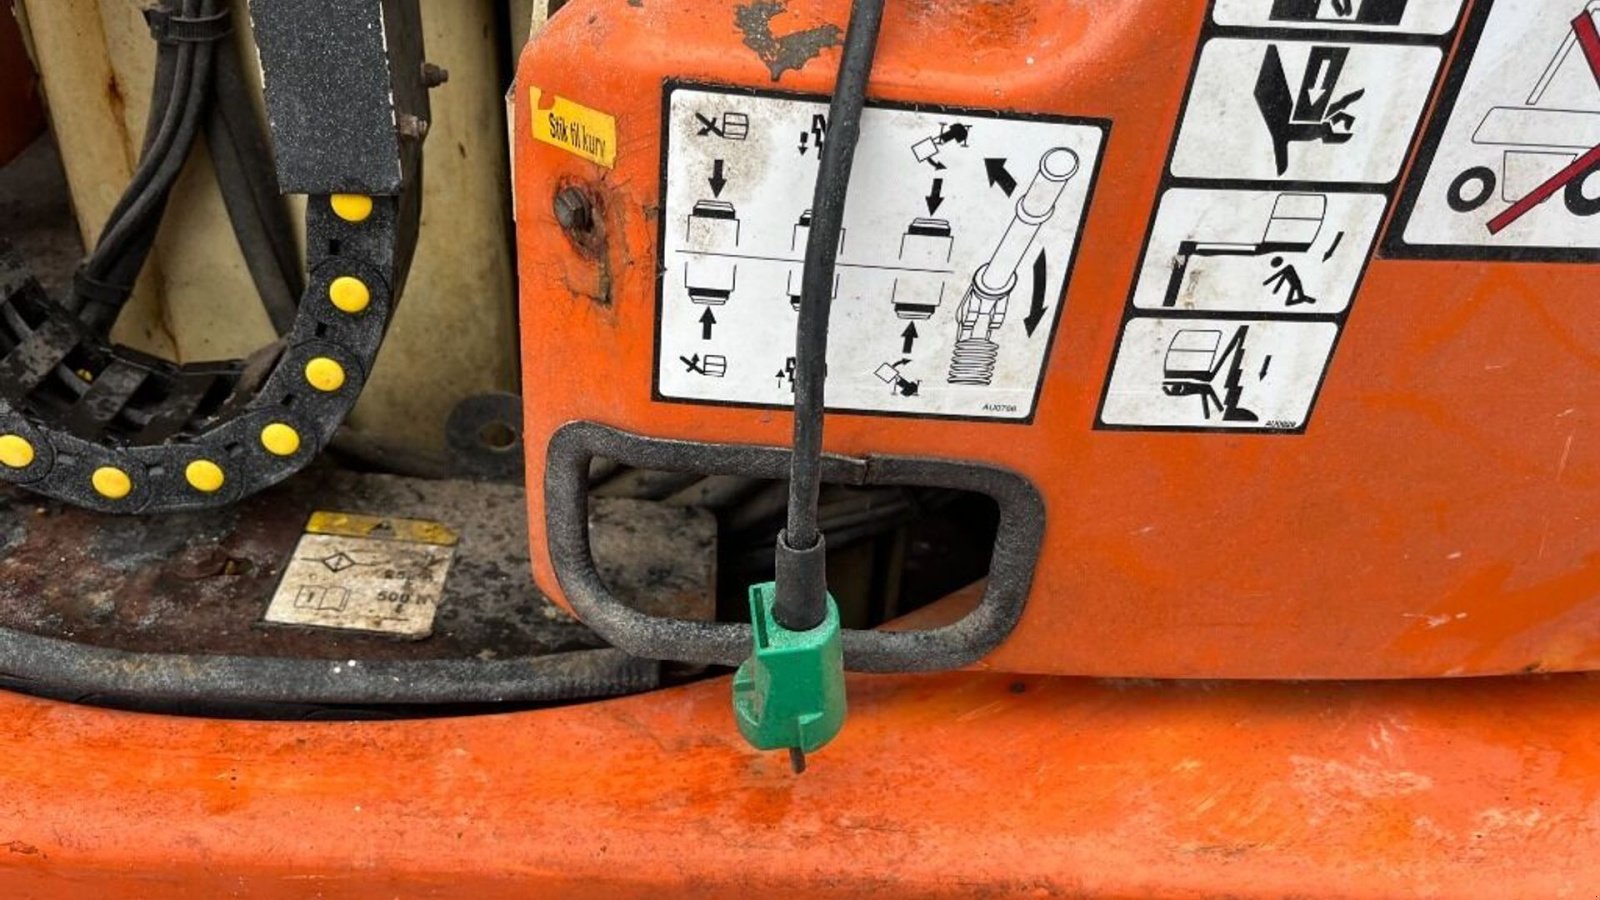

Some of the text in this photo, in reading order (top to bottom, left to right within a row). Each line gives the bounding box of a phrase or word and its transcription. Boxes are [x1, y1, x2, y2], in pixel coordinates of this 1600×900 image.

[548, 112, 606, 159] Stik til kurv
[377, 590, 410, 604] 500
